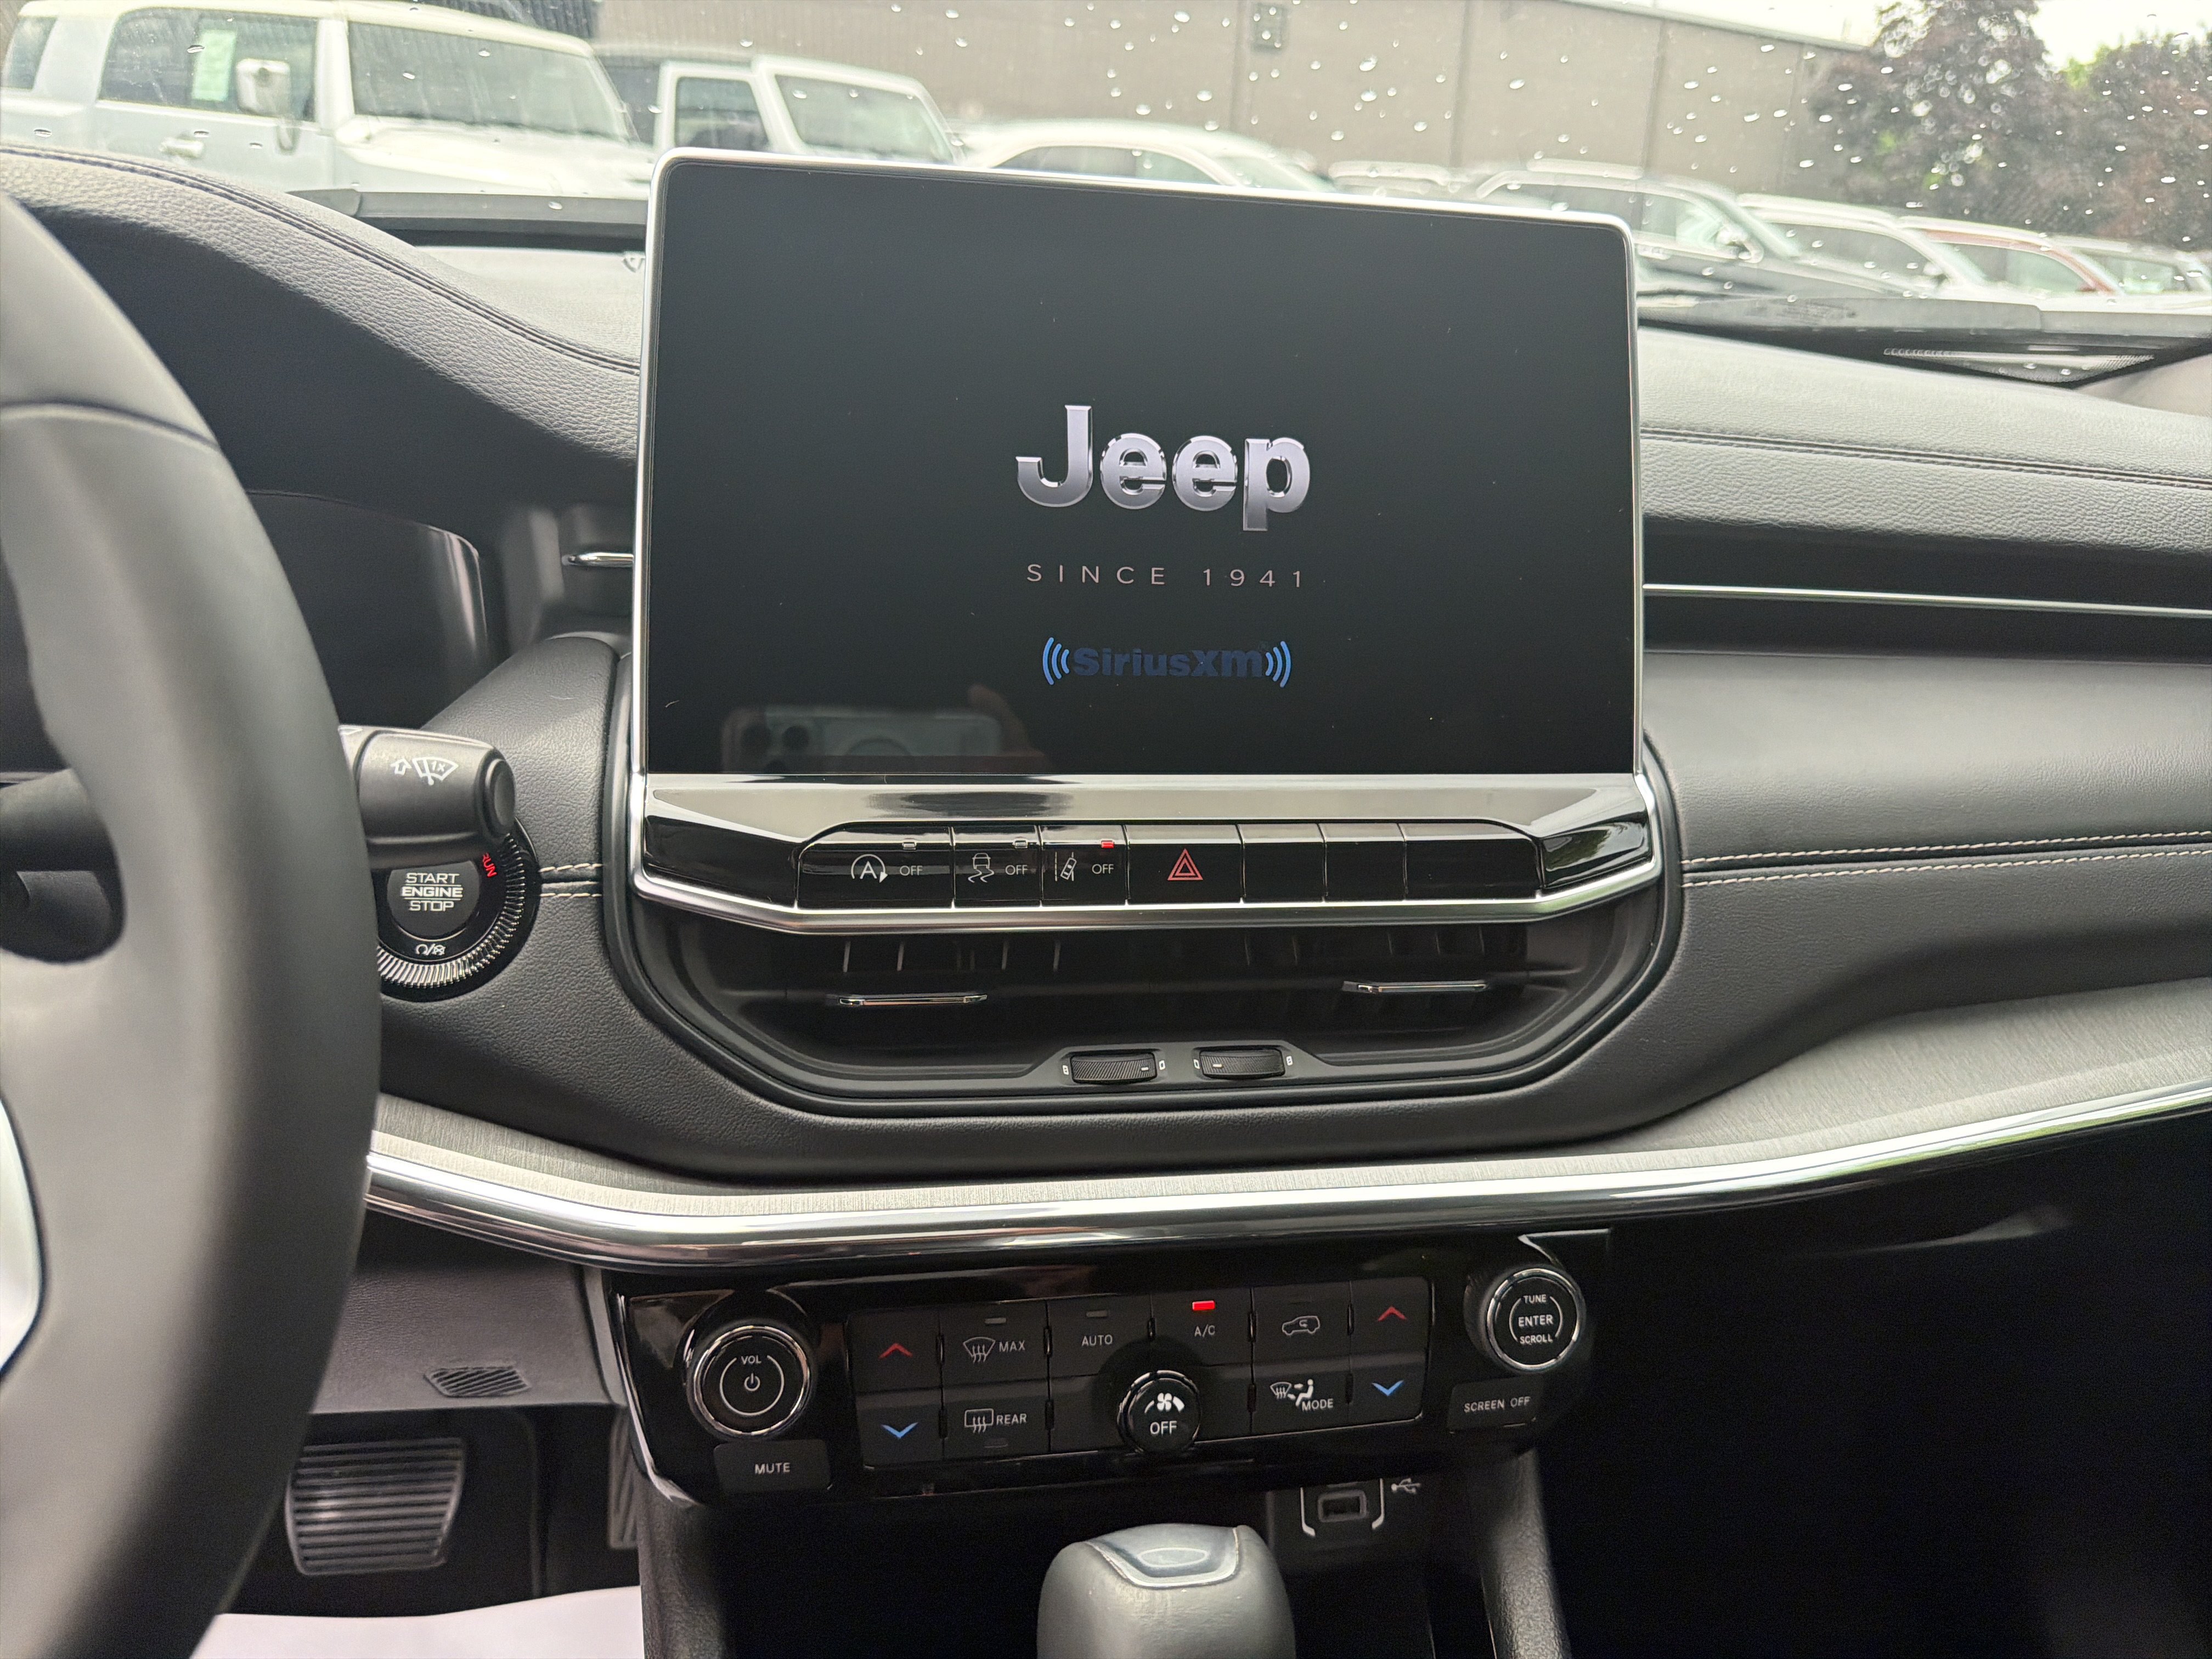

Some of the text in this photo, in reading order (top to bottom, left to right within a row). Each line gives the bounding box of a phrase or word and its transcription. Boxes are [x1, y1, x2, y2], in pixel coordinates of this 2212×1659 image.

[1016, 404, 1310, 531] Jeep
[1027, 564, 1301, 588] SINCE 1941
[899, 865, 923, 876] OFF
[1005, 865, 1028, 876] OFF
[1092, 864, 1114, 875] OFF
[405, 873, 460, 884] START
[401, 886, 463, 898] ENGINE
[409, 900, 454, 911] STOP
[1523, 1294, 1547, 1304] TUNE
[1518, 1314, 1554, 1328] ENTER
[1194, 1324, 1216, 1338] A/C
[1081, 1334, 1113, 1347] AUTO
[1519, 1334, 1553, 1345] SCROLL
[998, 1340, 1025, 1353] MAX
[741, 1355, 761, 1365] VOL
[1302, 1398, 1334, 1412] MODE
[1463, 1396, 1532, 1414] SCREEN OFF
[996, 1413, 1027, 1425] REAR
[1149, 1420, 1177, 1436] OFF
[754, 1462, 791, 1474] MUTE
